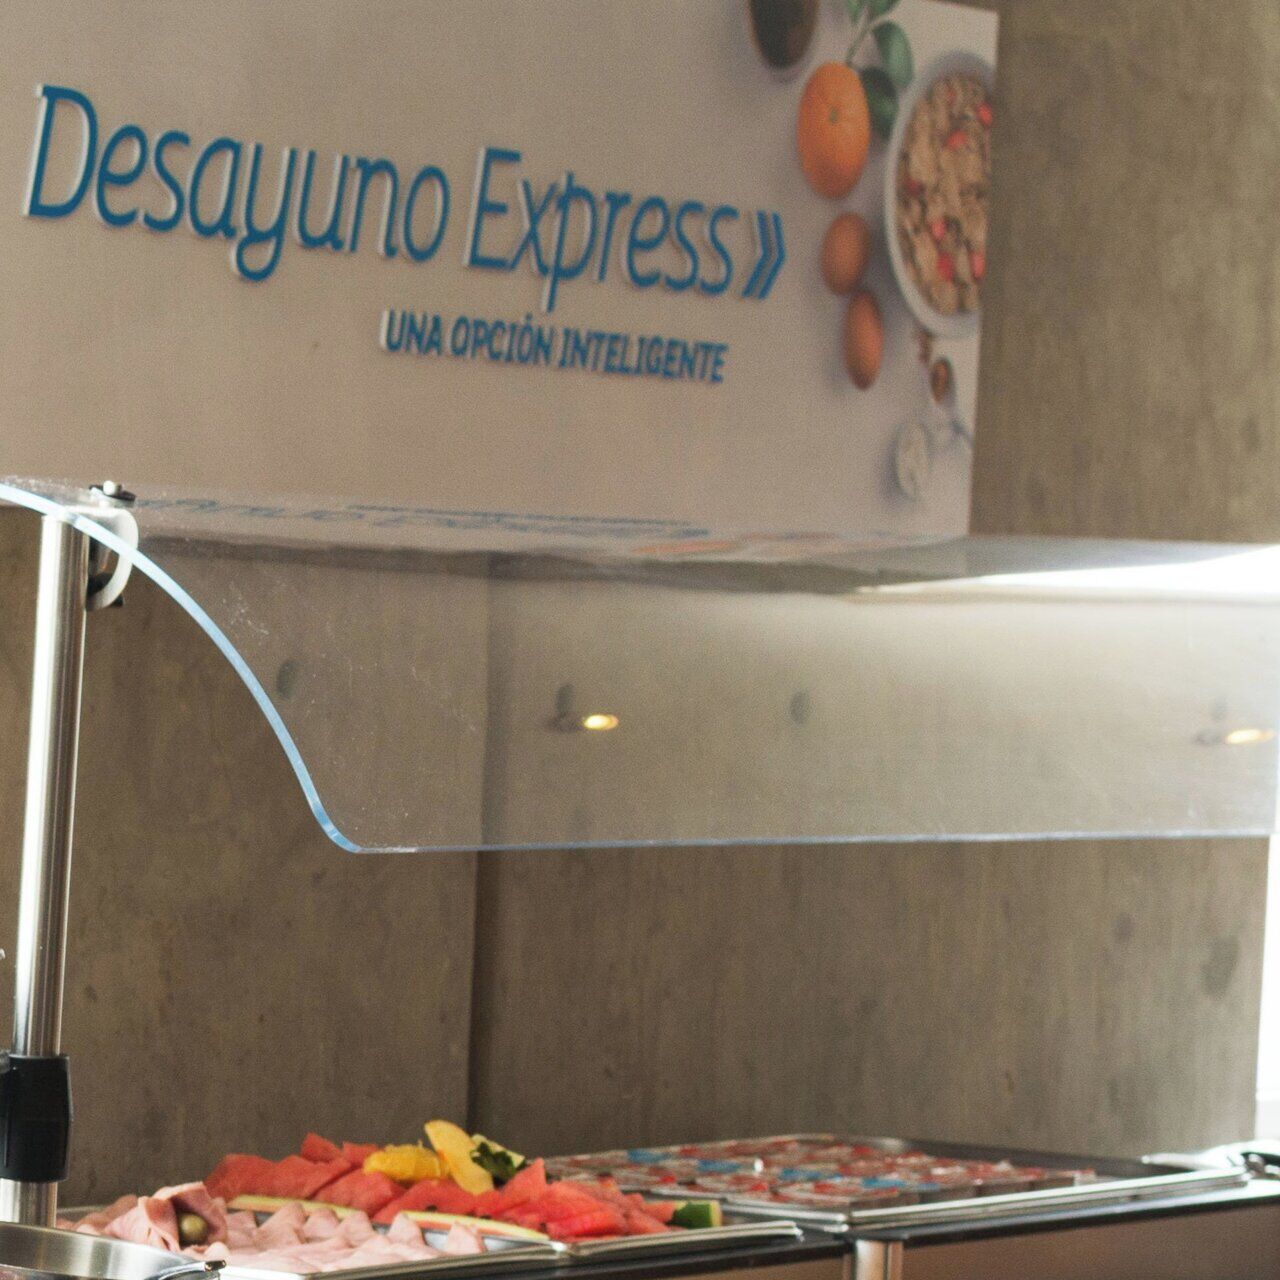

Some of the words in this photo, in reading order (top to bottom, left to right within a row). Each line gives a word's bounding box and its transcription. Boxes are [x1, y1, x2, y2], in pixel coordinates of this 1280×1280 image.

[23, 84, 450, 281] Desayuno
[464, 147, 739, 313] Express
[381, 310, 441, 357] UNA
[451, 313, 555, 366] OPCIÓN
[558, 326, 729, 385] INTELIGENTE
